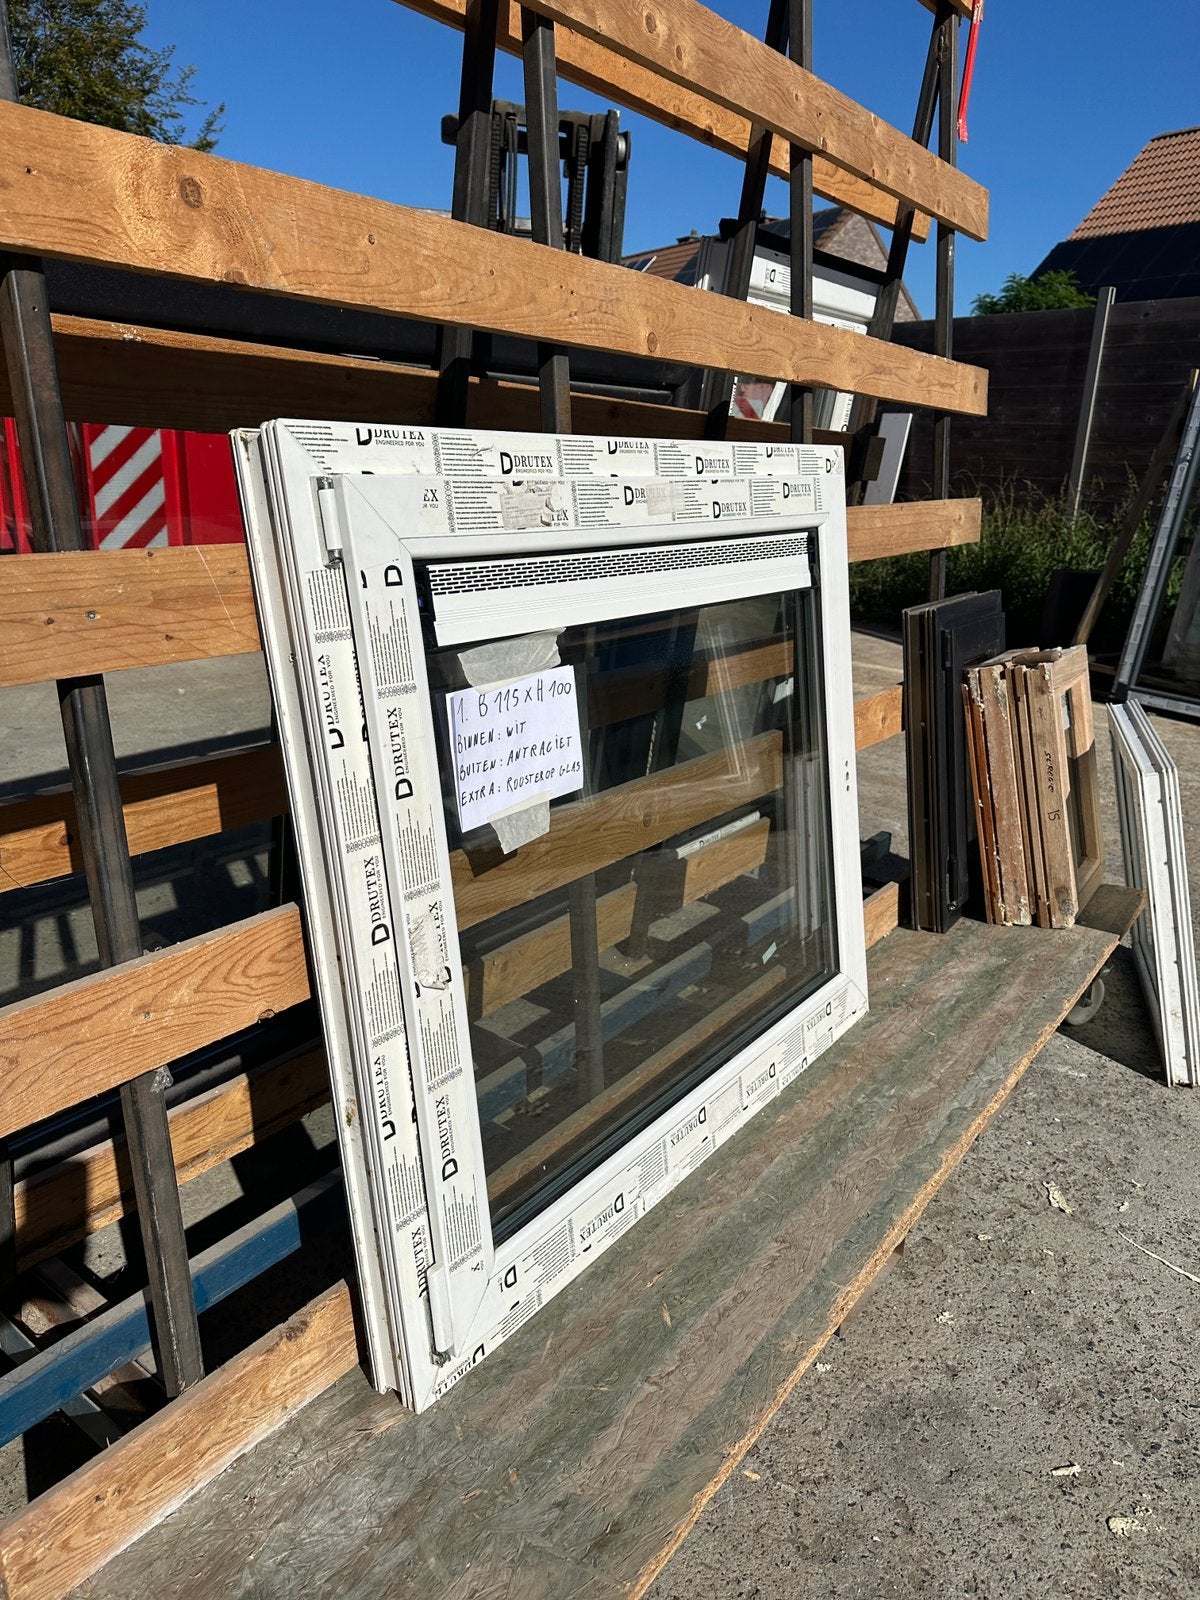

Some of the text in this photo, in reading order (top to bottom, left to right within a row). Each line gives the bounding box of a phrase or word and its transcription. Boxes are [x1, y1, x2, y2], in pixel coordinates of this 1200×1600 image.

[514, 455, 553, 468] DRUTEX
[704, 459, 730, 469] DRUTEX
[721, 502, 747, 512] DRUTEX
[494, 688, 520, 714] 115
[537, 678, 544, 702] H
[548, 680, 572, 698] 100
[387, 707, 405, 778] DRUTEX
[559, 761, 581, 777] GLAS
[364, 856, 382, 924] DRUTEX
[436, 1096, 451, 1160] DRUTEX
[670, 1115, 699, 1148] DRUTEX
[580, 1208, 614, 1243] DRUTEX
